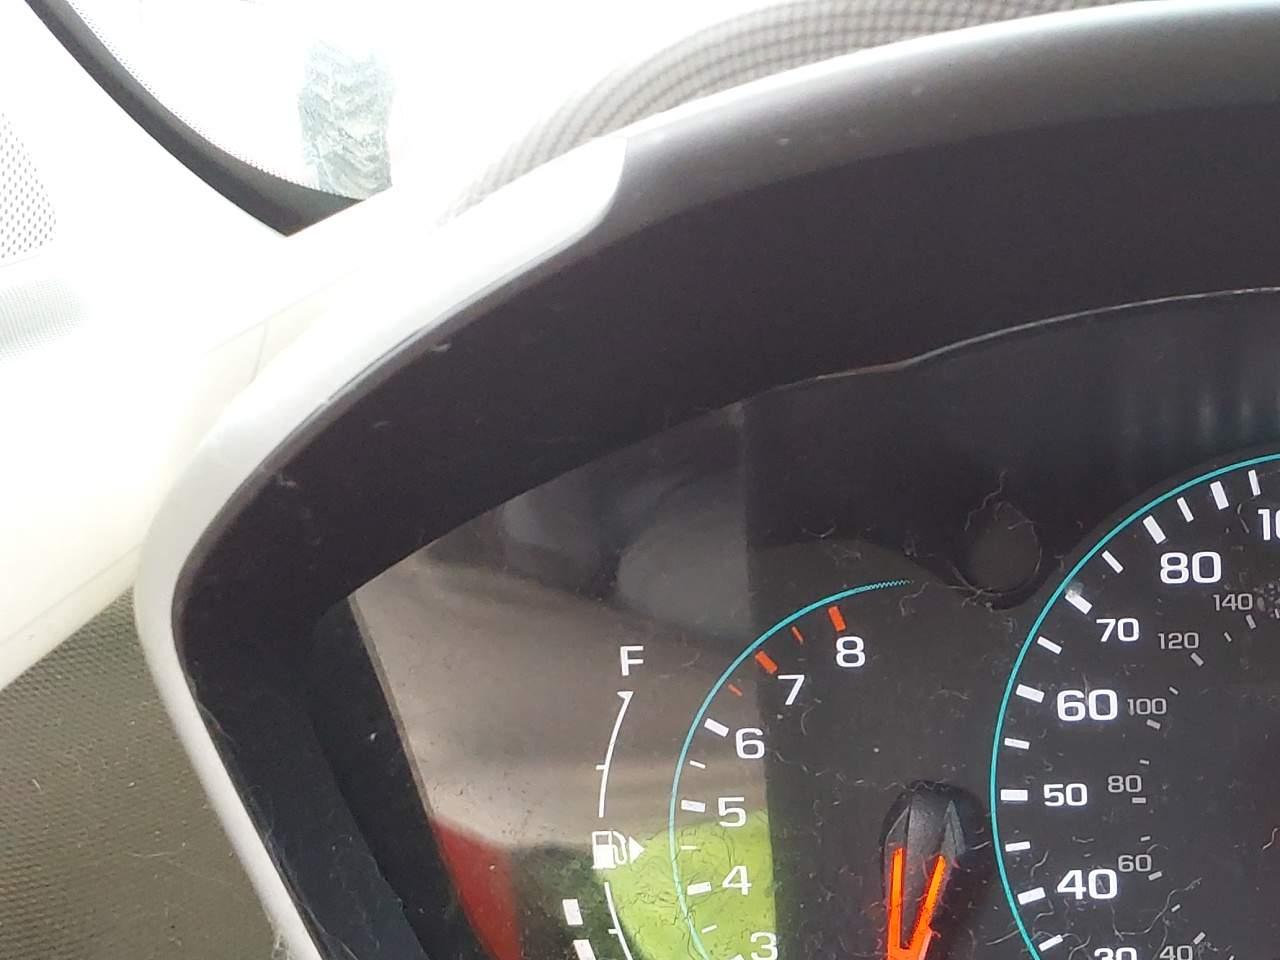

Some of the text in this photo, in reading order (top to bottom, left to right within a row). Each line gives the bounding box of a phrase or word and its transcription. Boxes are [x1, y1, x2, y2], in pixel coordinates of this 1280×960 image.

[1160, 551, 1222, 585] 80
[1213, 592, 1253, 611] 140
[1096, 618, 1140, 642] 70
[1158, 632, 1199, 650] 120
[619, 645, 644, 676] F
[835, 637, 866, 668] 8
[778, 675, 805, 705] 7
[1056, 689, 1119, 722] 60
[1127, 698, 1167, 716] 100
[735, 728, 765, 759] 6
[1043, 783, 1088, 807] 50
[1107, 775, 1142, 793] 80
[717, 796, 746, 827] 5
[1118, 854, 1152, 873] 60
[722, 865, 752, 896] 4
[1057, 869, 1118, 900] 40
